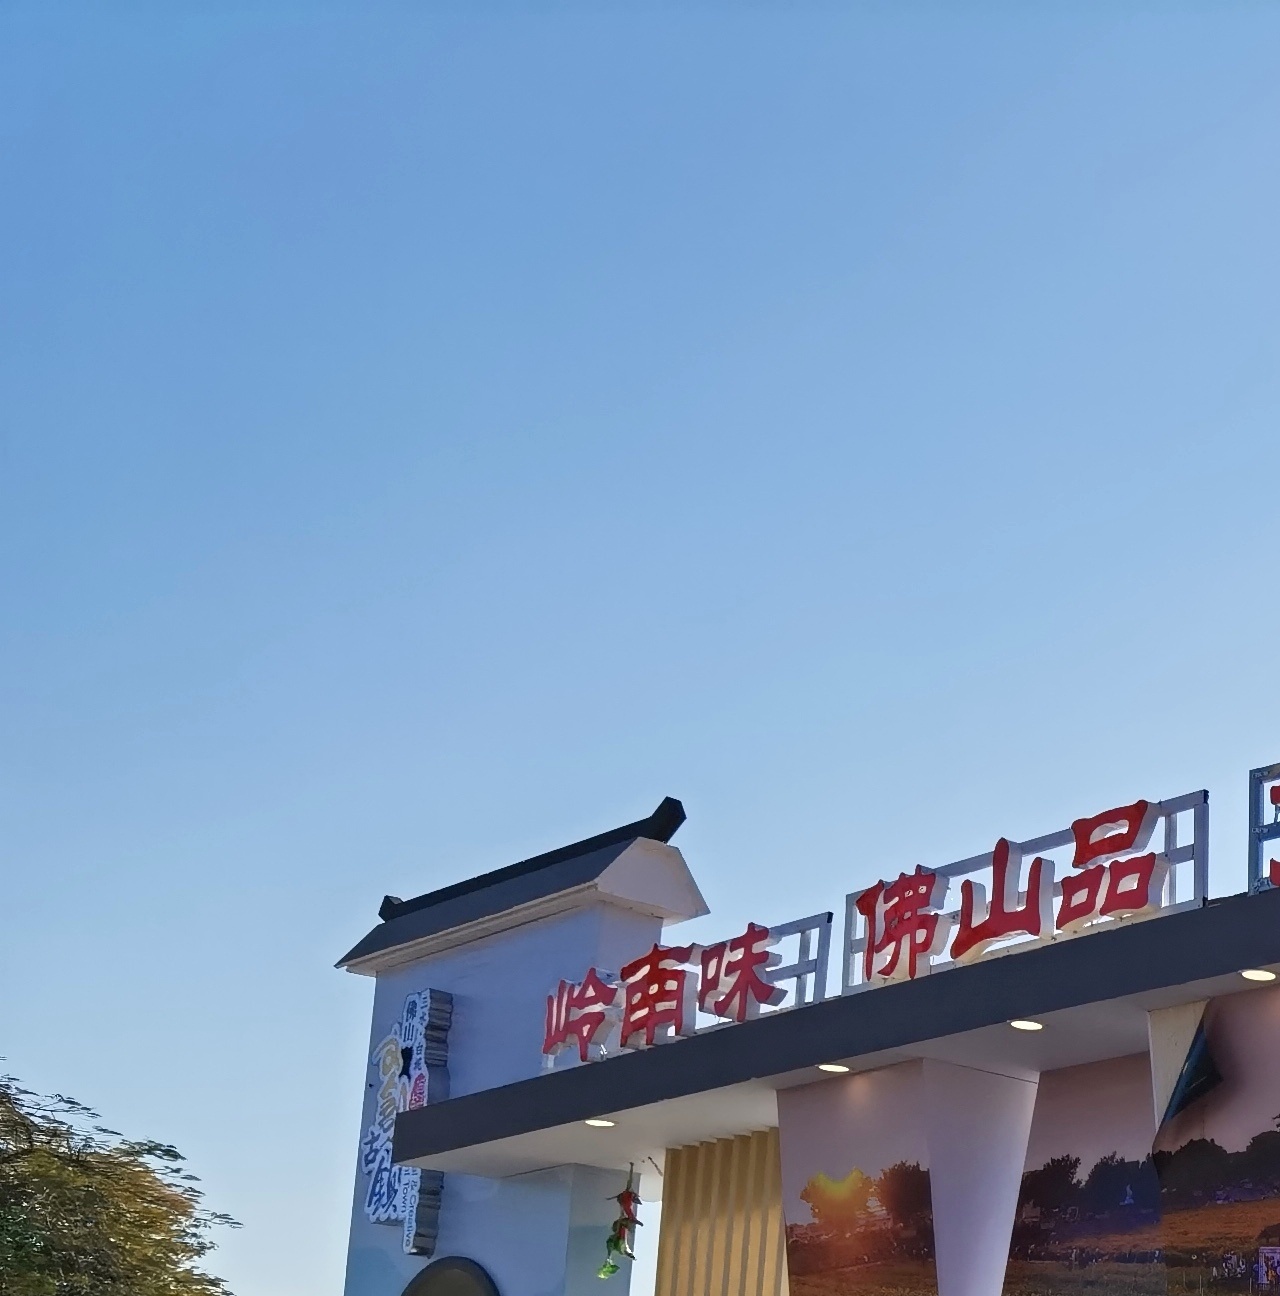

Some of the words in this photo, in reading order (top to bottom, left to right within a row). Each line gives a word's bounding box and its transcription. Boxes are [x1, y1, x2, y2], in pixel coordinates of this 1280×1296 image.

[542, 922, 786, 1062] 岭南味
[856, 799, 1167, 981] 佛山品
